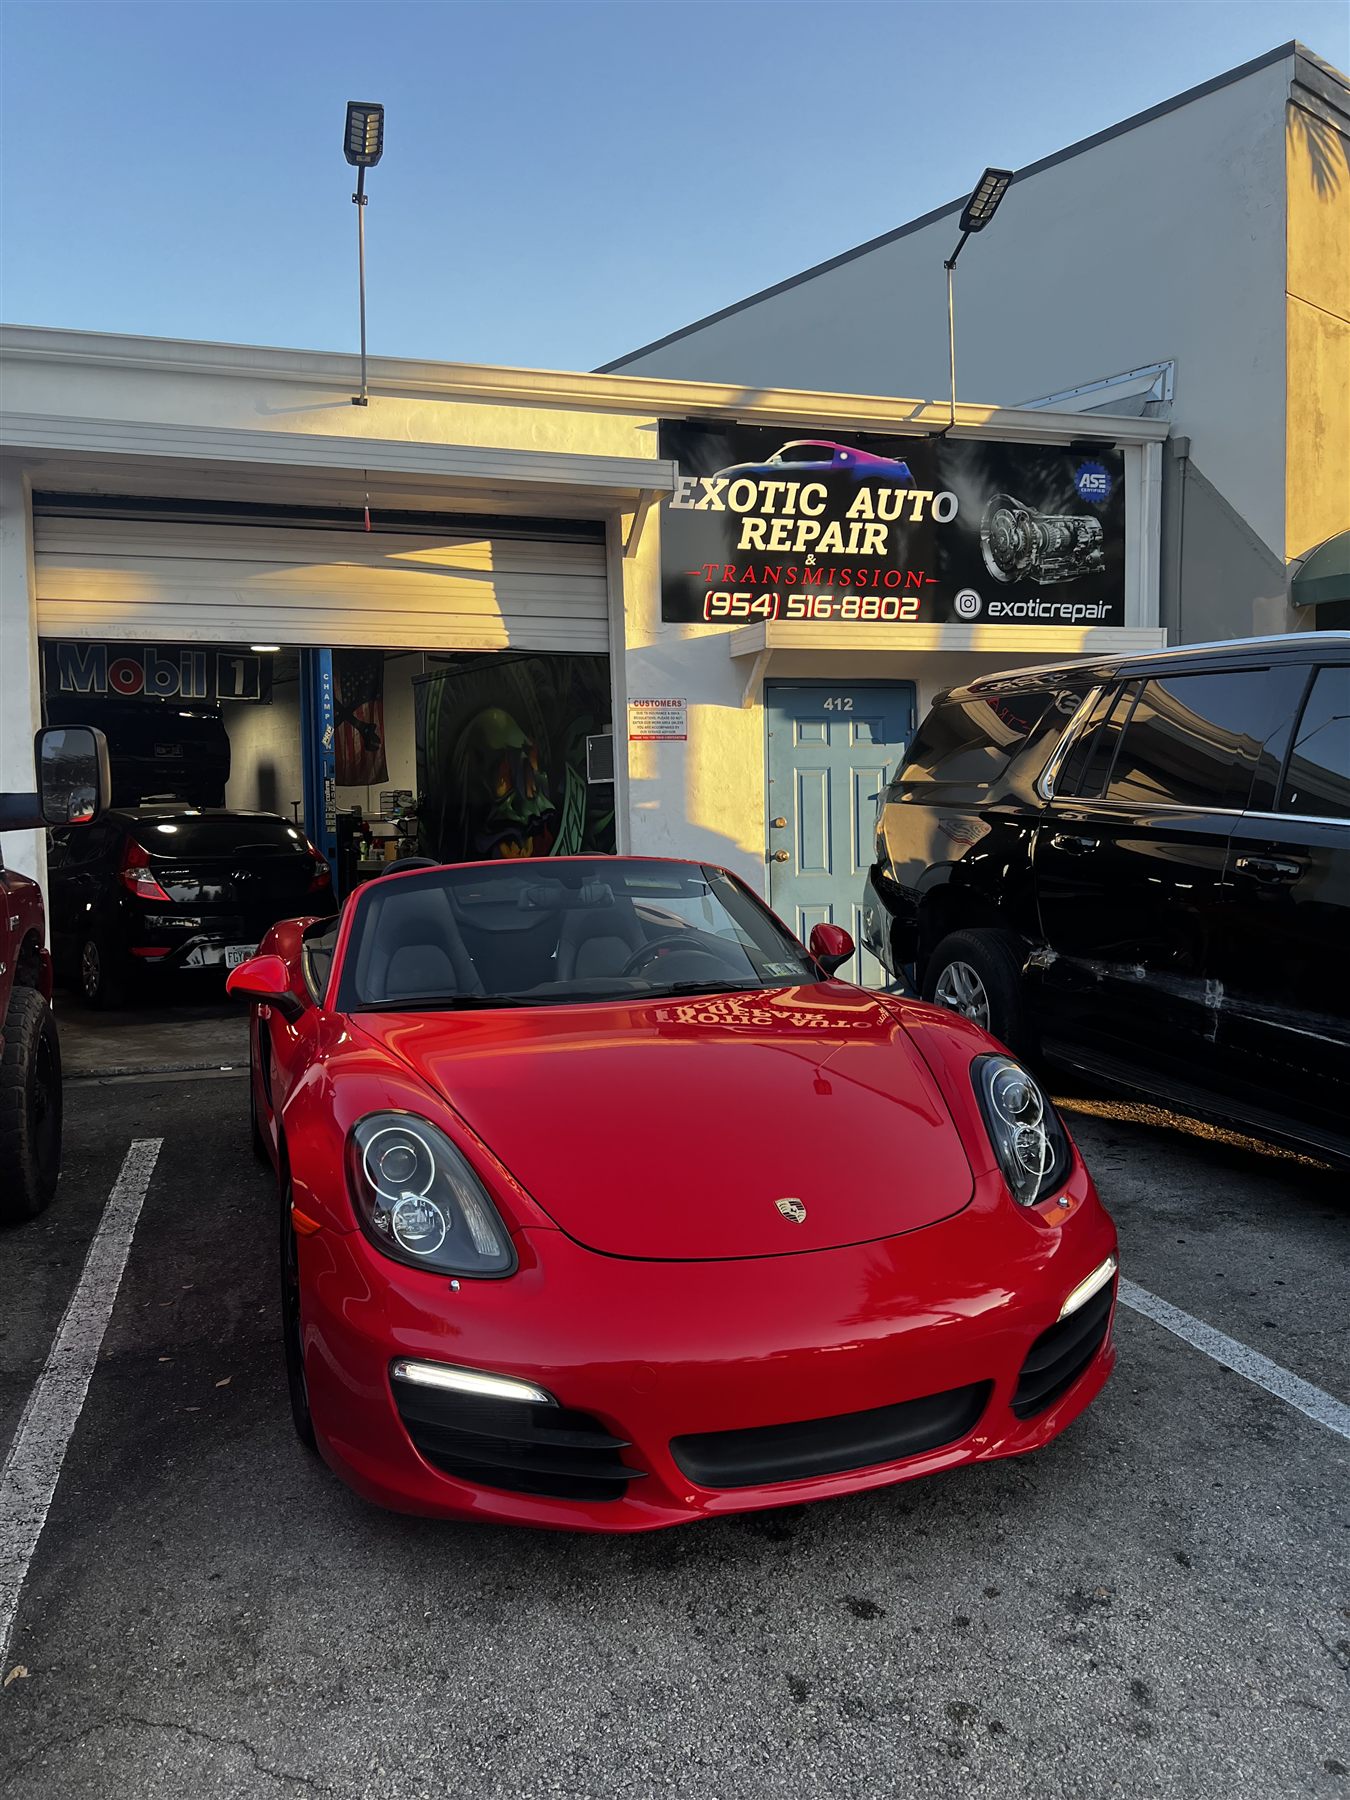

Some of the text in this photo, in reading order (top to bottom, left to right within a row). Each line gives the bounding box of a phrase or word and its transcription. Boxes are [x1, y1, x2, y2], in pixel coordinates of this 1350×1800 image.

[1079, 473, 1106, 488] ASE
[669, 476, 959, 523] EXOTIC AUTO
[737, 516, 889, 556] REPAIR
[804, 554, 817, 566] &
[702, 563, 925, 588] TRANSMISSION
[703, 590, 921, 621] (954) 516-8802
[988, 598, 1113, 622] exoticrepair
[57, 643, 207, 697] Mobil
[633, 699, 682, 707] CUSTOMERS
[823, 697, 853, 711] 412
